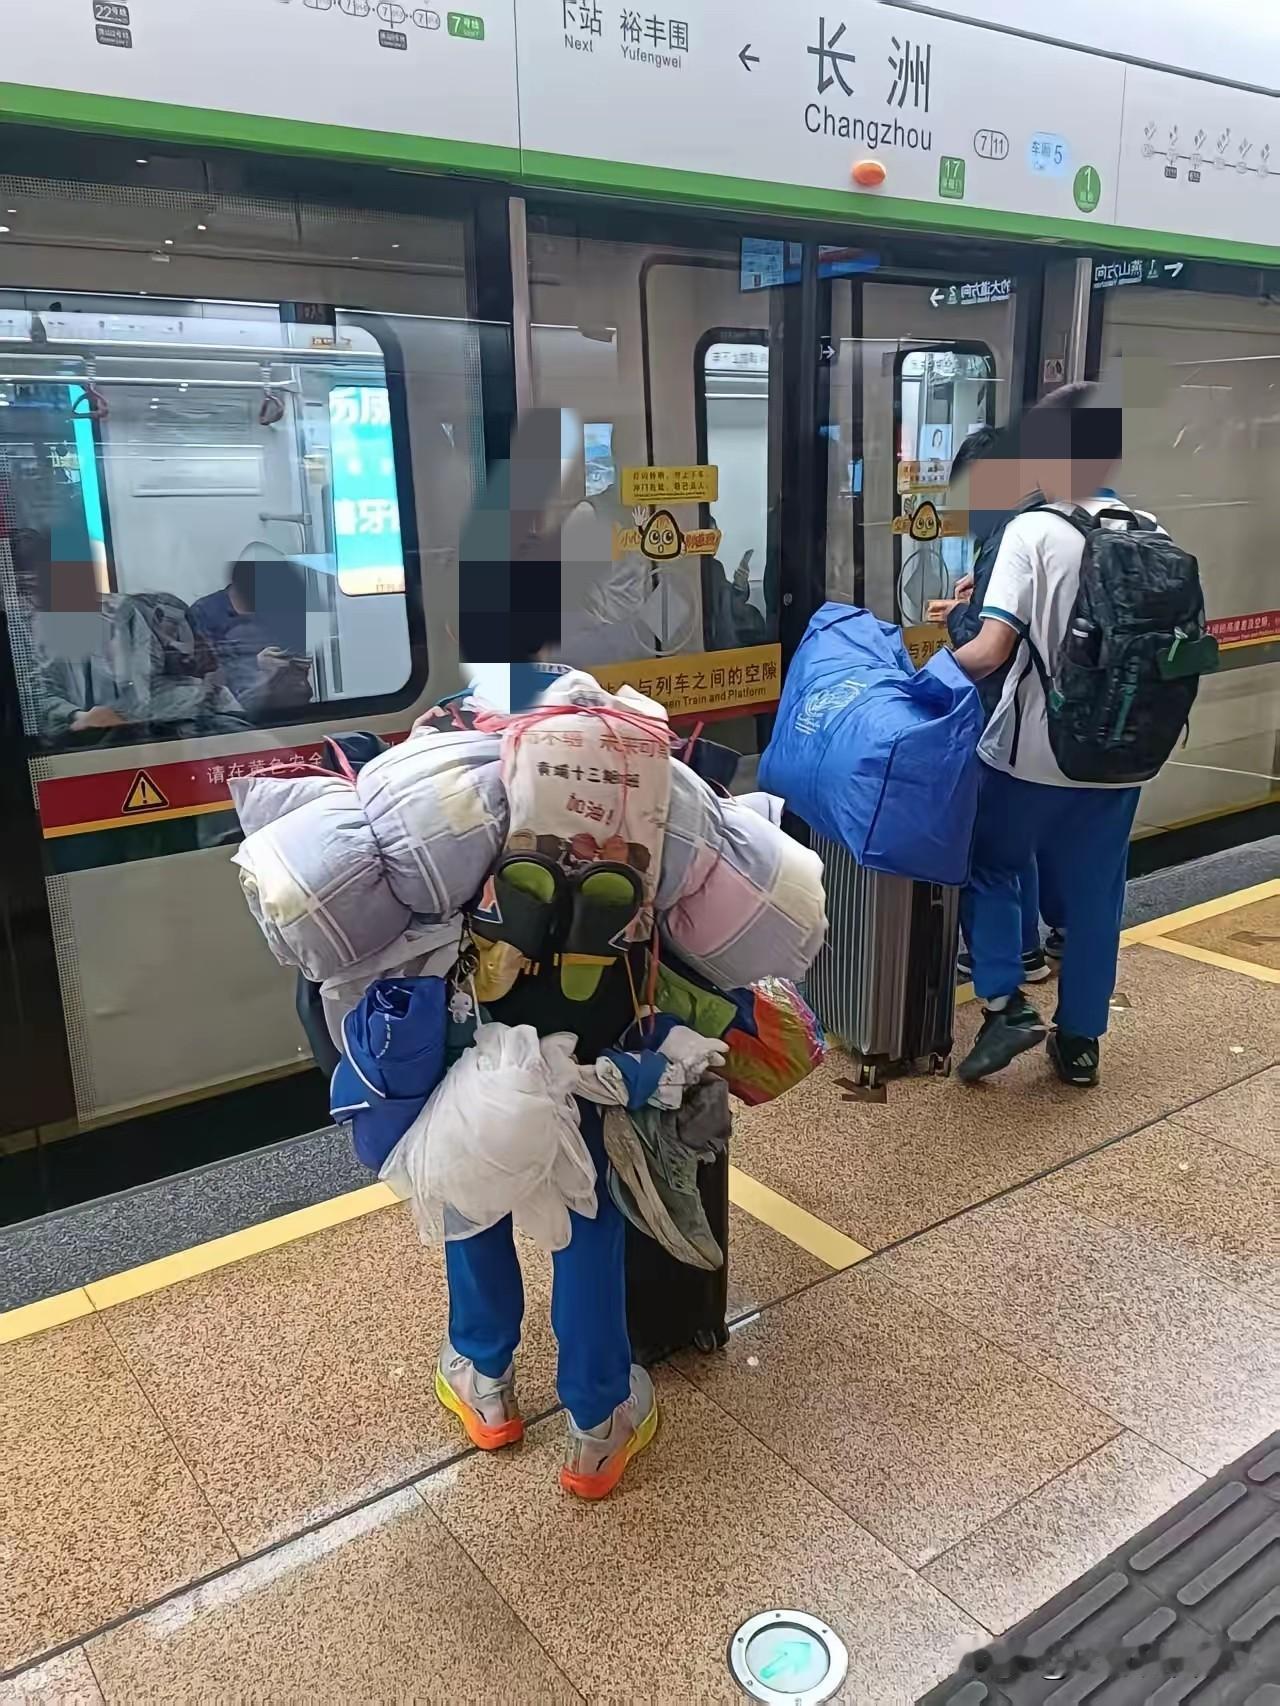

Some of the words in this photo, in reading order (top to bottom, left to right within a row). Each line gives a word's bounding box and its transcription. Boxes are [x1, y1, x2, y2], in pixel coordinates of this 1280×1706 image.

[564, 34, 593, 53] Next
[619, 8, 689, 53] 裕丰围
[620, 44, 682, 70] Yufengwei
[804, 103, 932, 151] Changzhou
[601, 662, 777, 697] 与列车之间的空隙
[683, 694, 706, 707] Train
[709, 690, 726, 703] and
[728, 686, 766, 700] Platform
